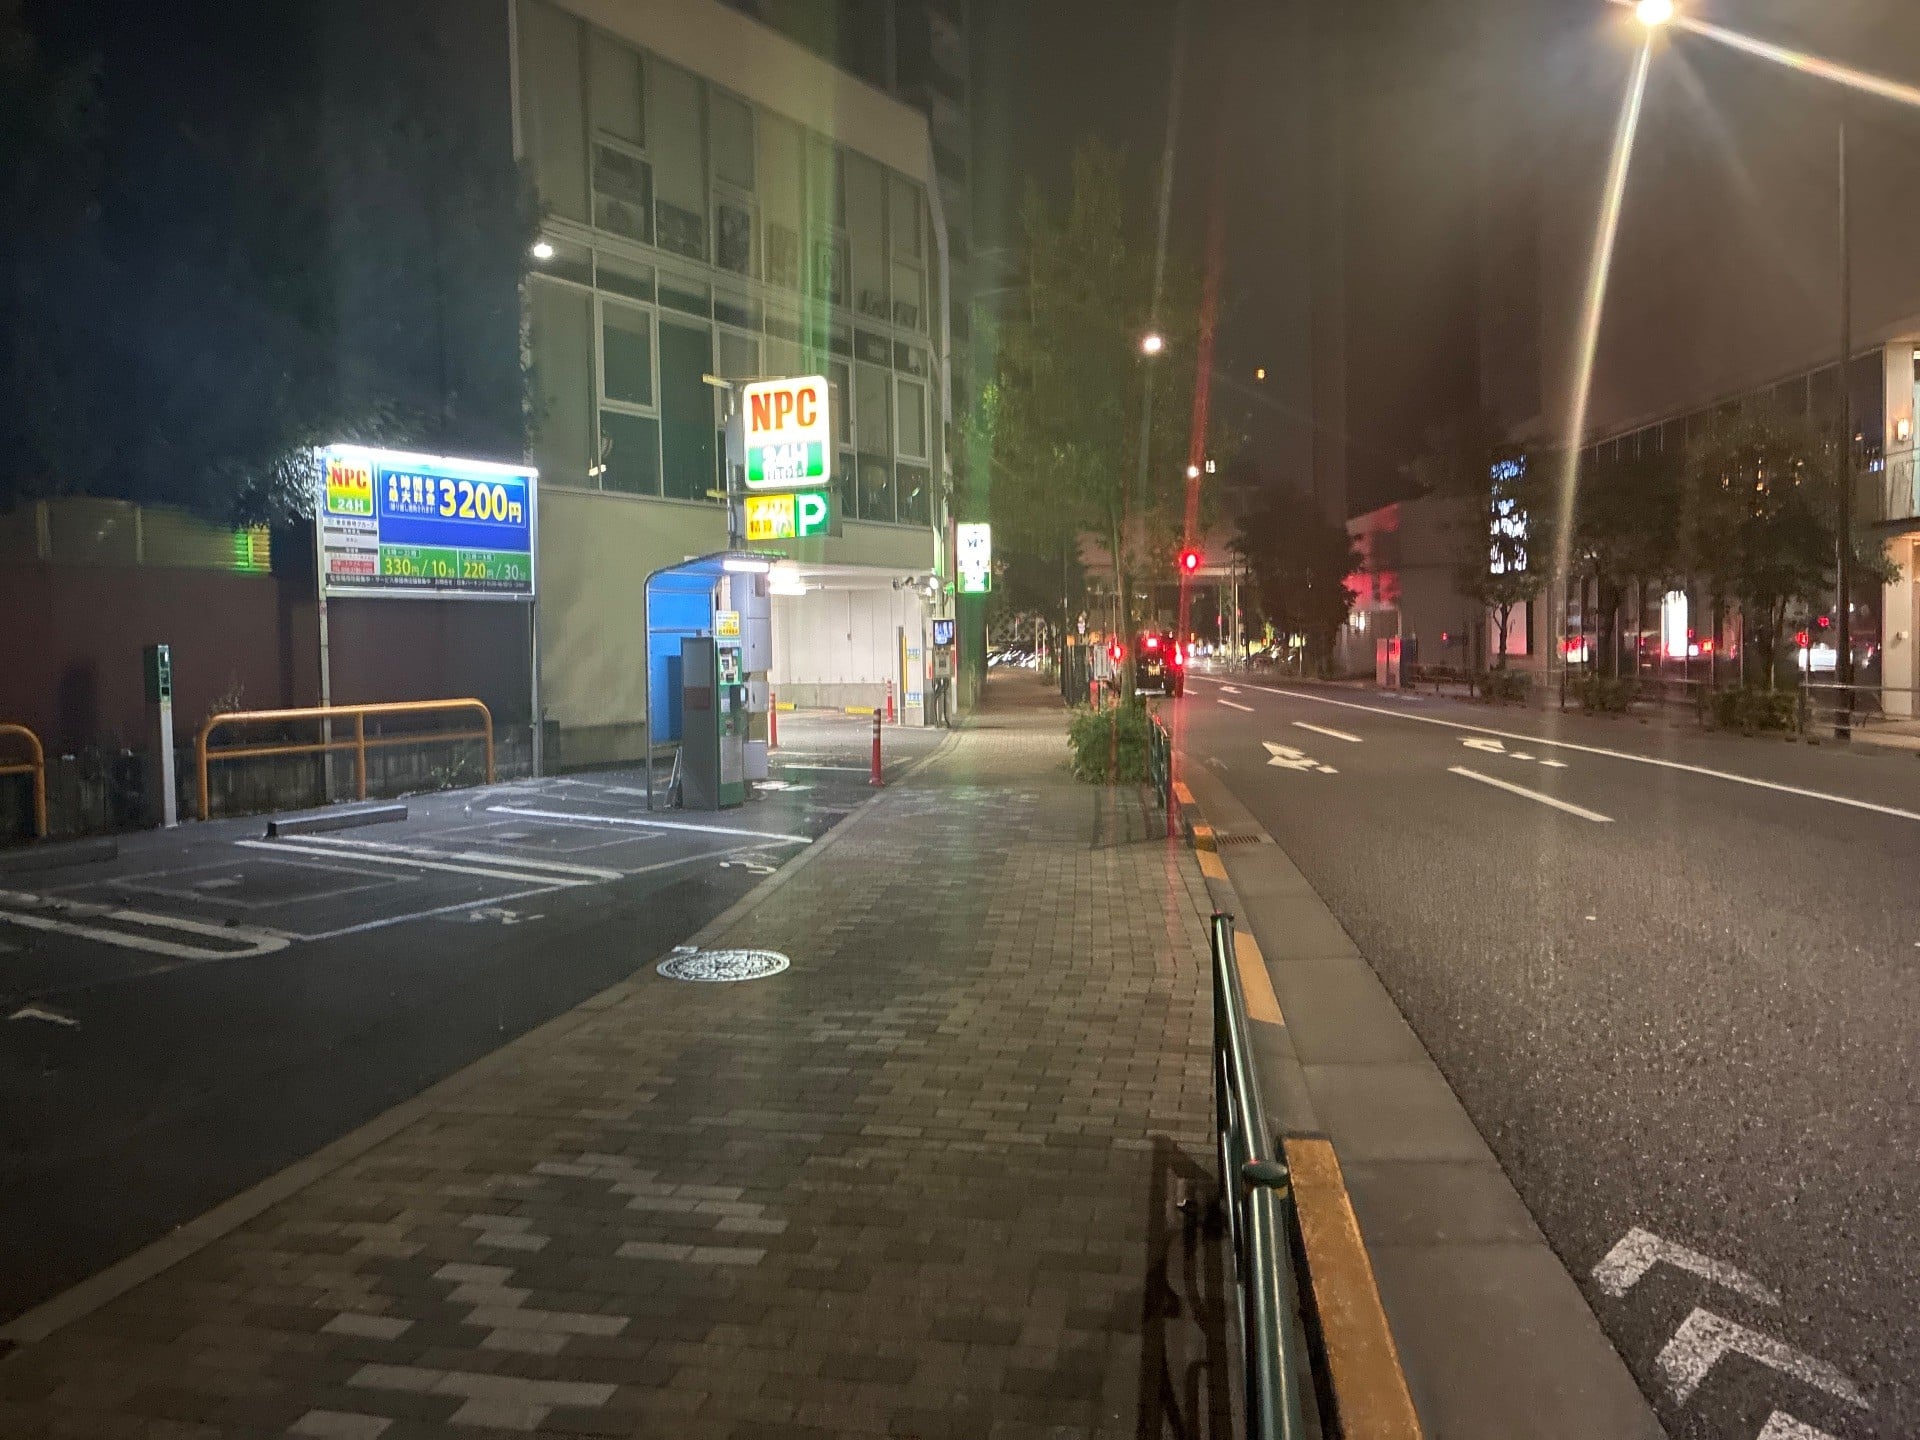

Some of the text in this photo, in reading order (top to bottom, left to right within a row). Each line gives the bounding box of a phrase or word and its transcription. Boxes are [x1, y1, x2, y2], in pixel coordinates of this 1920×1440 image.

[751, 388, 817, 432] NPC
[331, 466, 367, 489] NPC
[337, 498, 365, 513] 24H
[439, 478, 522, 523] 3200円
[798, 493, 827, 537] P
